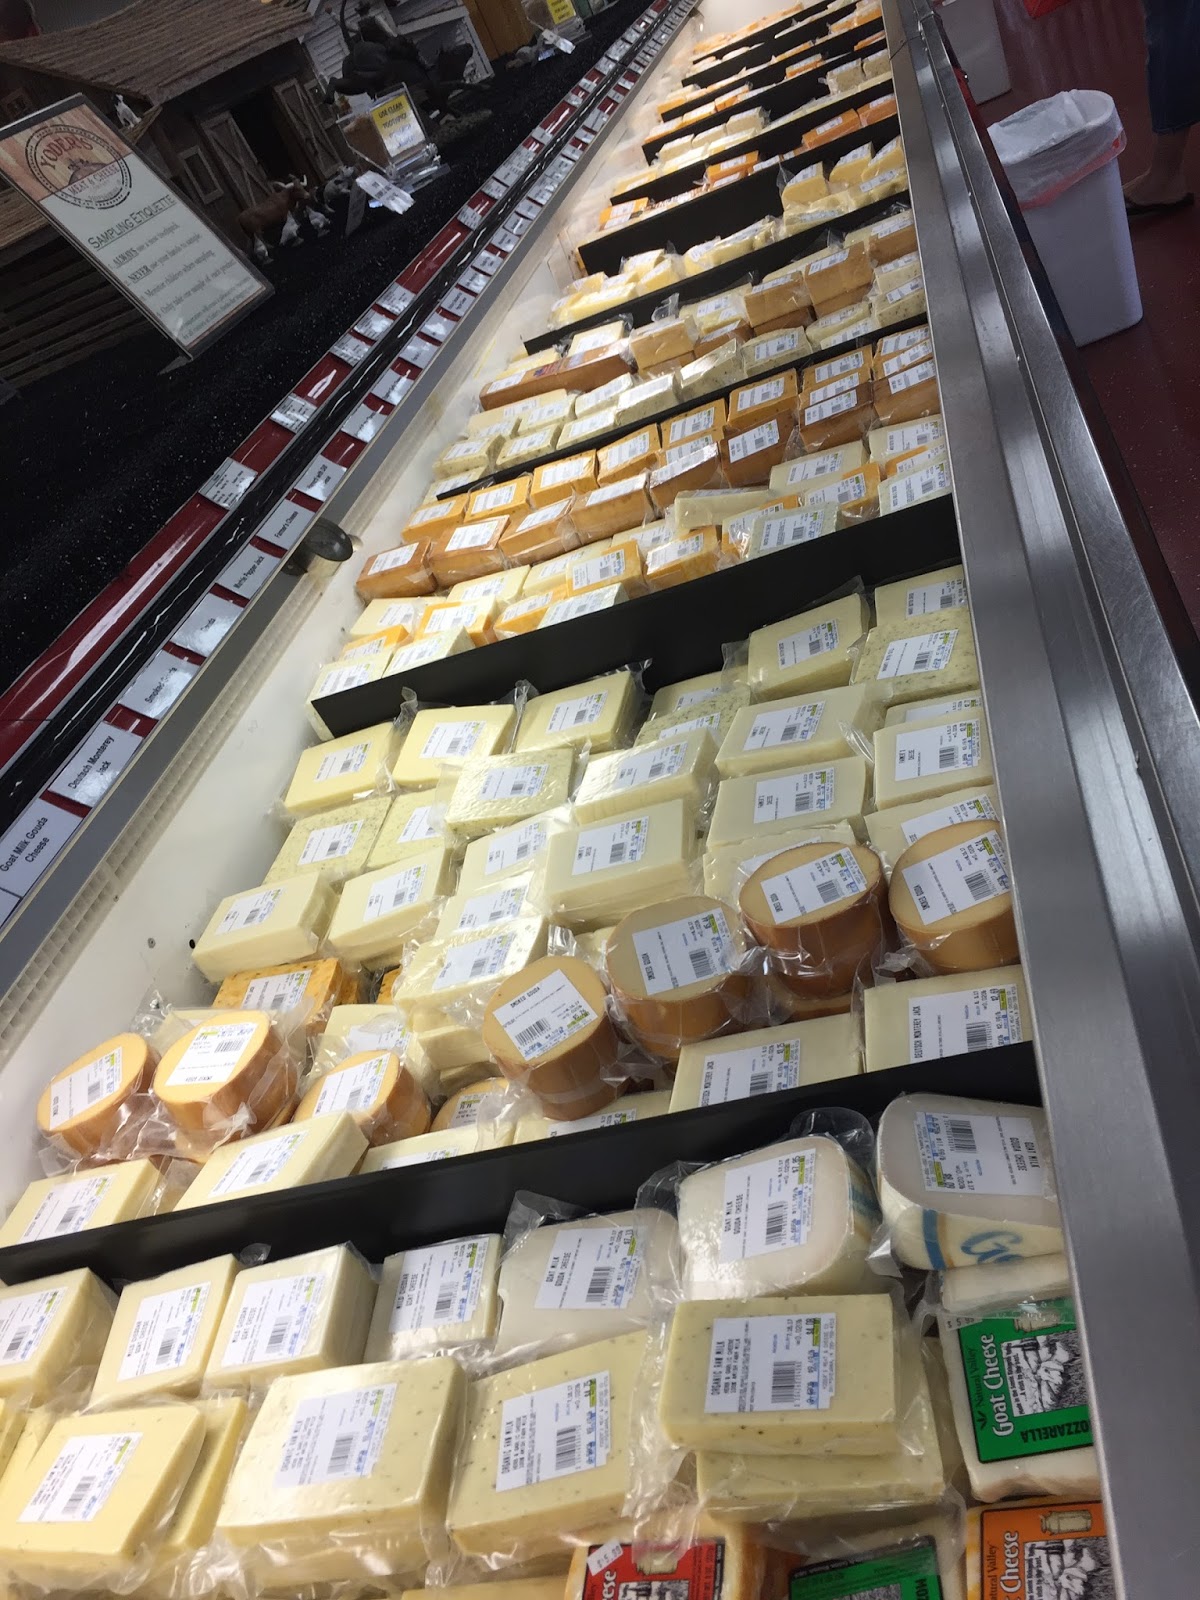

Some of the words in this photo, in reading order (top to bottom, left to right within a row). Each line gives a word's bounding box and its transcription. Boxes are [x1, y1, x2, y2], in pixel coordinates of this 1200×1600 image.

[40, 135, 94, 170] YODER'S
[68, 178, 89, 196] MEAT
[93, 164, 120, 184] CHEESE
[88, 218, 134, 250] SAMPLING
[130, 193, 175, 223] ETIQUETTE
[128, 264, 151, 283] NEVER
[274, 520, 290, 539] Farmer's
[285, 511, 299, 526] Cheese
[145, 681, 165, 704] Smoked
[68, 763, 92, 790] Deutsch
[87, 736, 115, 766] Monterey
[97, 760, 112, 776] Jack
[0, 854, 19, 872] Goat
[16, 838, 31, 857] Milk
[25, 817, 49, 841] Gouda
[25, 837, 50, 863] Cheese
[912, 1005, 921, 1017] JACK
[913, 1019, 922, 1040] MONTEREY
[914, 1040, 923, 1059] DEUTSCH
[1010, 1137, 1021, 1151] GOUDA
[1024, 1141, 1035, 1155] GOAT
[1014, 1151, 1028, 1172] CHEESE
[1028, 1155, 1039, 1168] MILK
[725, 1200, 733, 1215] MILK
[735, 1193, 743, 1214] CHEESE
[724, 1216, 732, 1232] GOAT
[733, 1216, 741, 1234] GOUDA
[549, 1255, 560, 1269] MILK
[559, 1250, 572, 1270] CHEESE
[408, 1271, 418, 1292] CHEESE
[554, 1269, 566, 1287] GOUDA
[711, 1372, 721, 1396] ORGANIC
[716, 1341, 725, 1357] MILK
[981, 1333, 1004, 1390] Cheese
[1016, 1379, 1025, 1390] visit
[992, 1393, 1015, 1437] Goat
[1015, 1403, 1025, 1414] Made
[502, 1450, 511, 1475] ORGANIC
[986, 1544, 1000, 1573] Valley
[1000, 1531, 1022, 1594] Cheese
[989, 1573, 999, 1600] atural
[1034, 1584, 1043, 1597] visit
